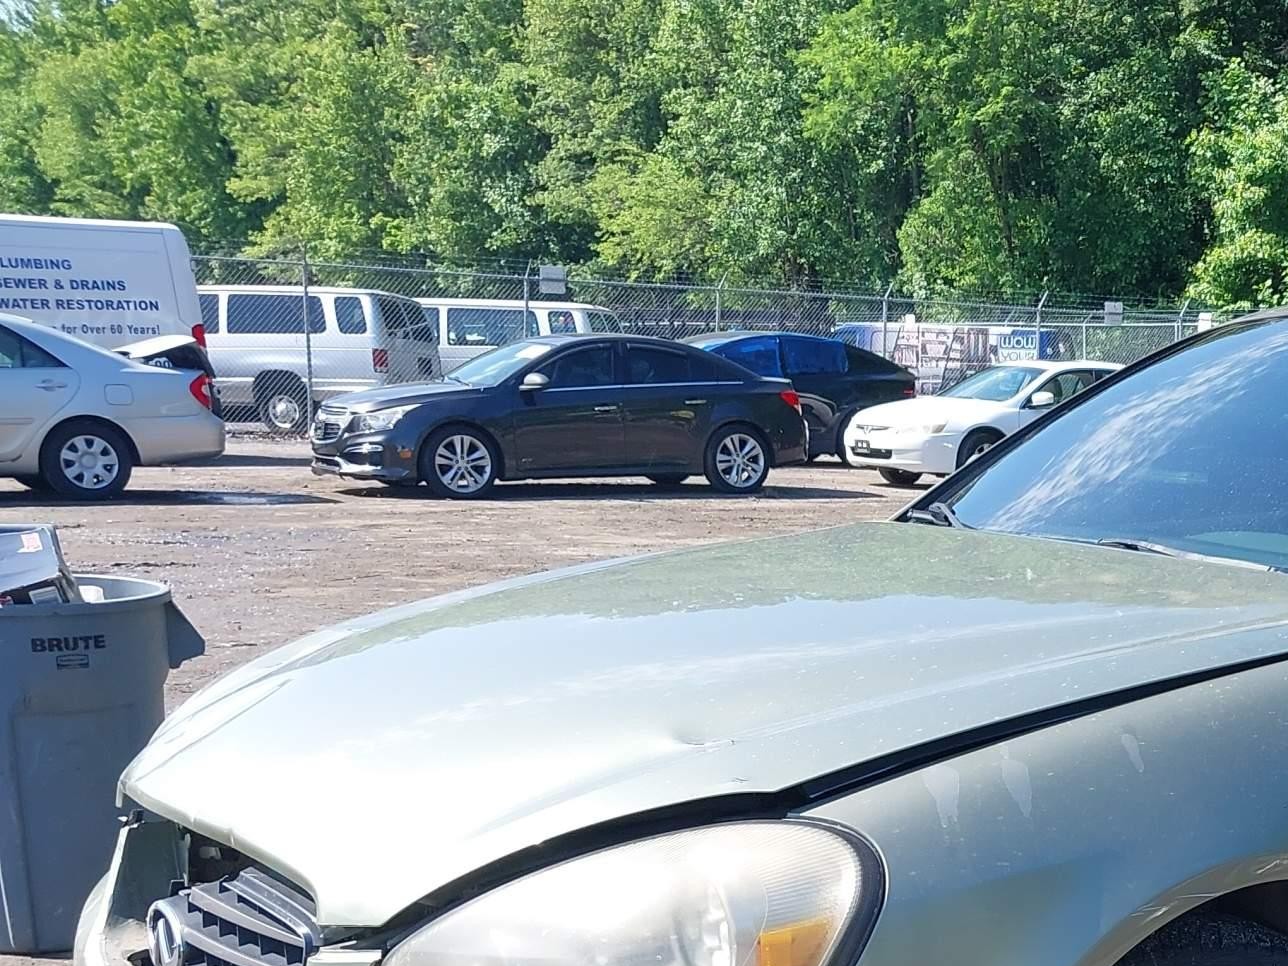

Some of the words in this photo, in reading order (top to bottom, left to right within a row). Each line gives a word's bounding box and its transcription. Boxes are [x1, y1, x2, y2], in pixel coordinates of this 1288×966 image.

[0, 277, 49, 290] EWER
[54, 279, 65, 290] &
[69, 279, 127, 291] DRAINS
[55, 299, 160, 311] RESTORATION
[81, 324, 106, 335] Over
[110, 324, 123, 335] 60
[127, 324, 161, 336] Years!
[1001, 335, 1036, 349] WOW
[31, 635, 106, 652] BRUTE
